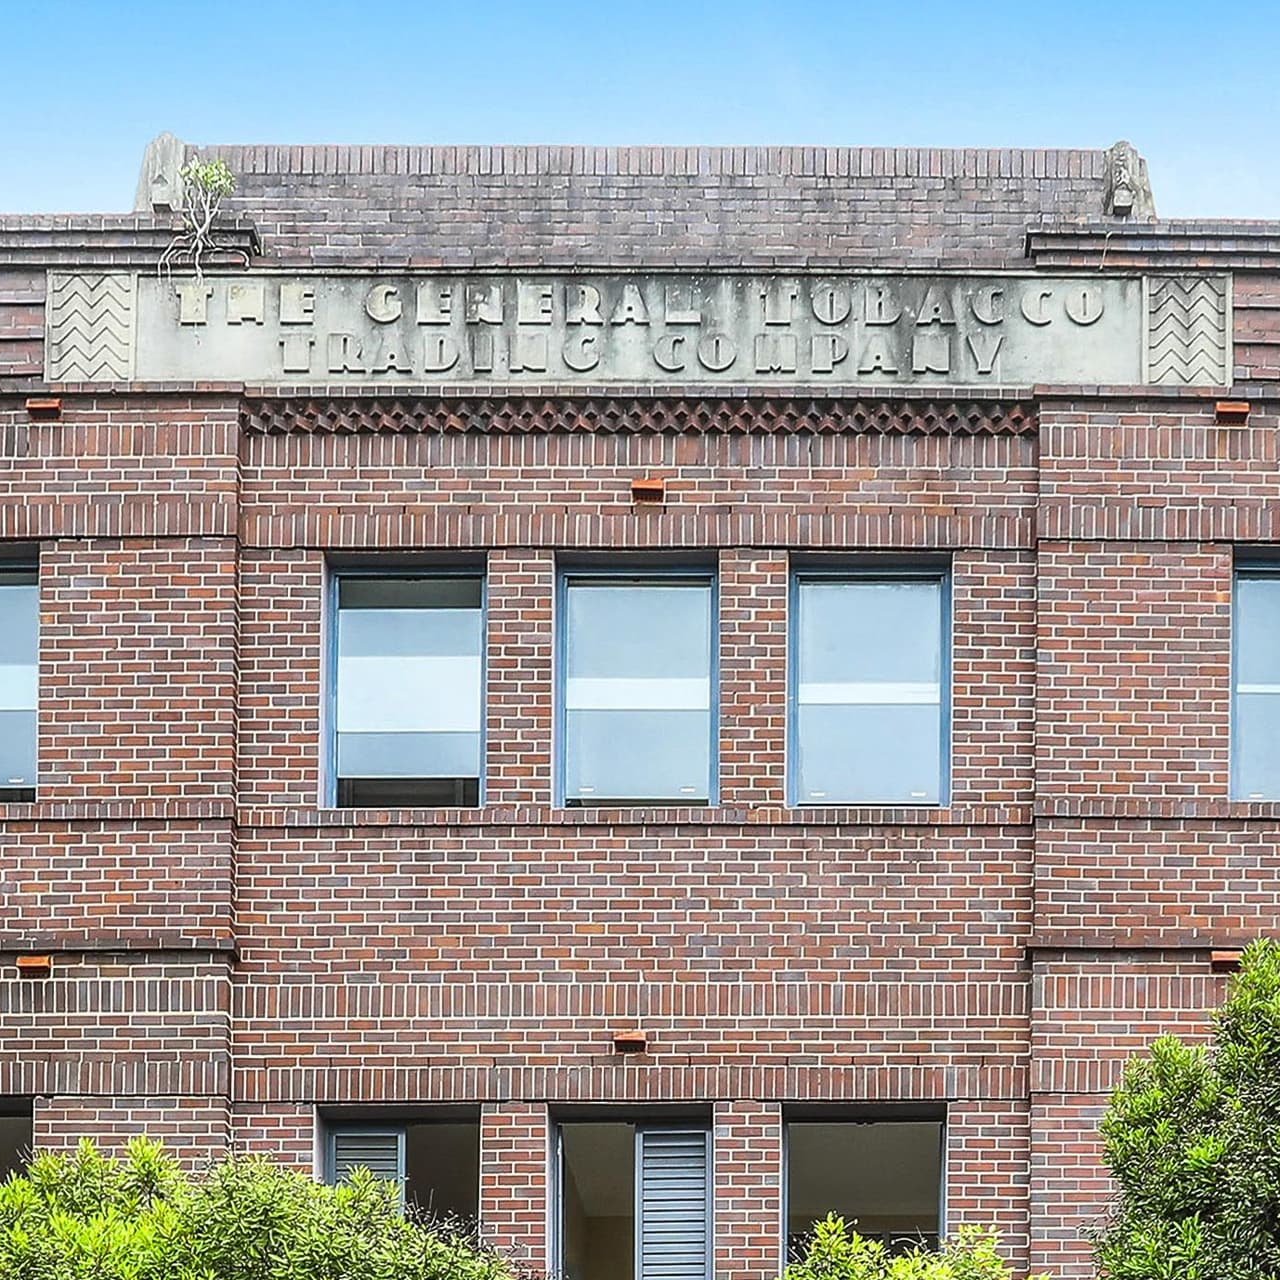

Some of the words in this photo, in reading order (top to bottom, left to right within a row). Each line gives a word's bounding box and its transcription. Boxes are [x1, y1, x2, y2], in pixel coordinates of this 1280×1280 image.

[175, 283, 315, 326] THE
[365, 283, 702, 326] GENERAL
[759, 285, 1105, 327] TOBACCO
[278, 332, 603, 374] TRADING
[652, 333, 1005, 375] COMPANY
